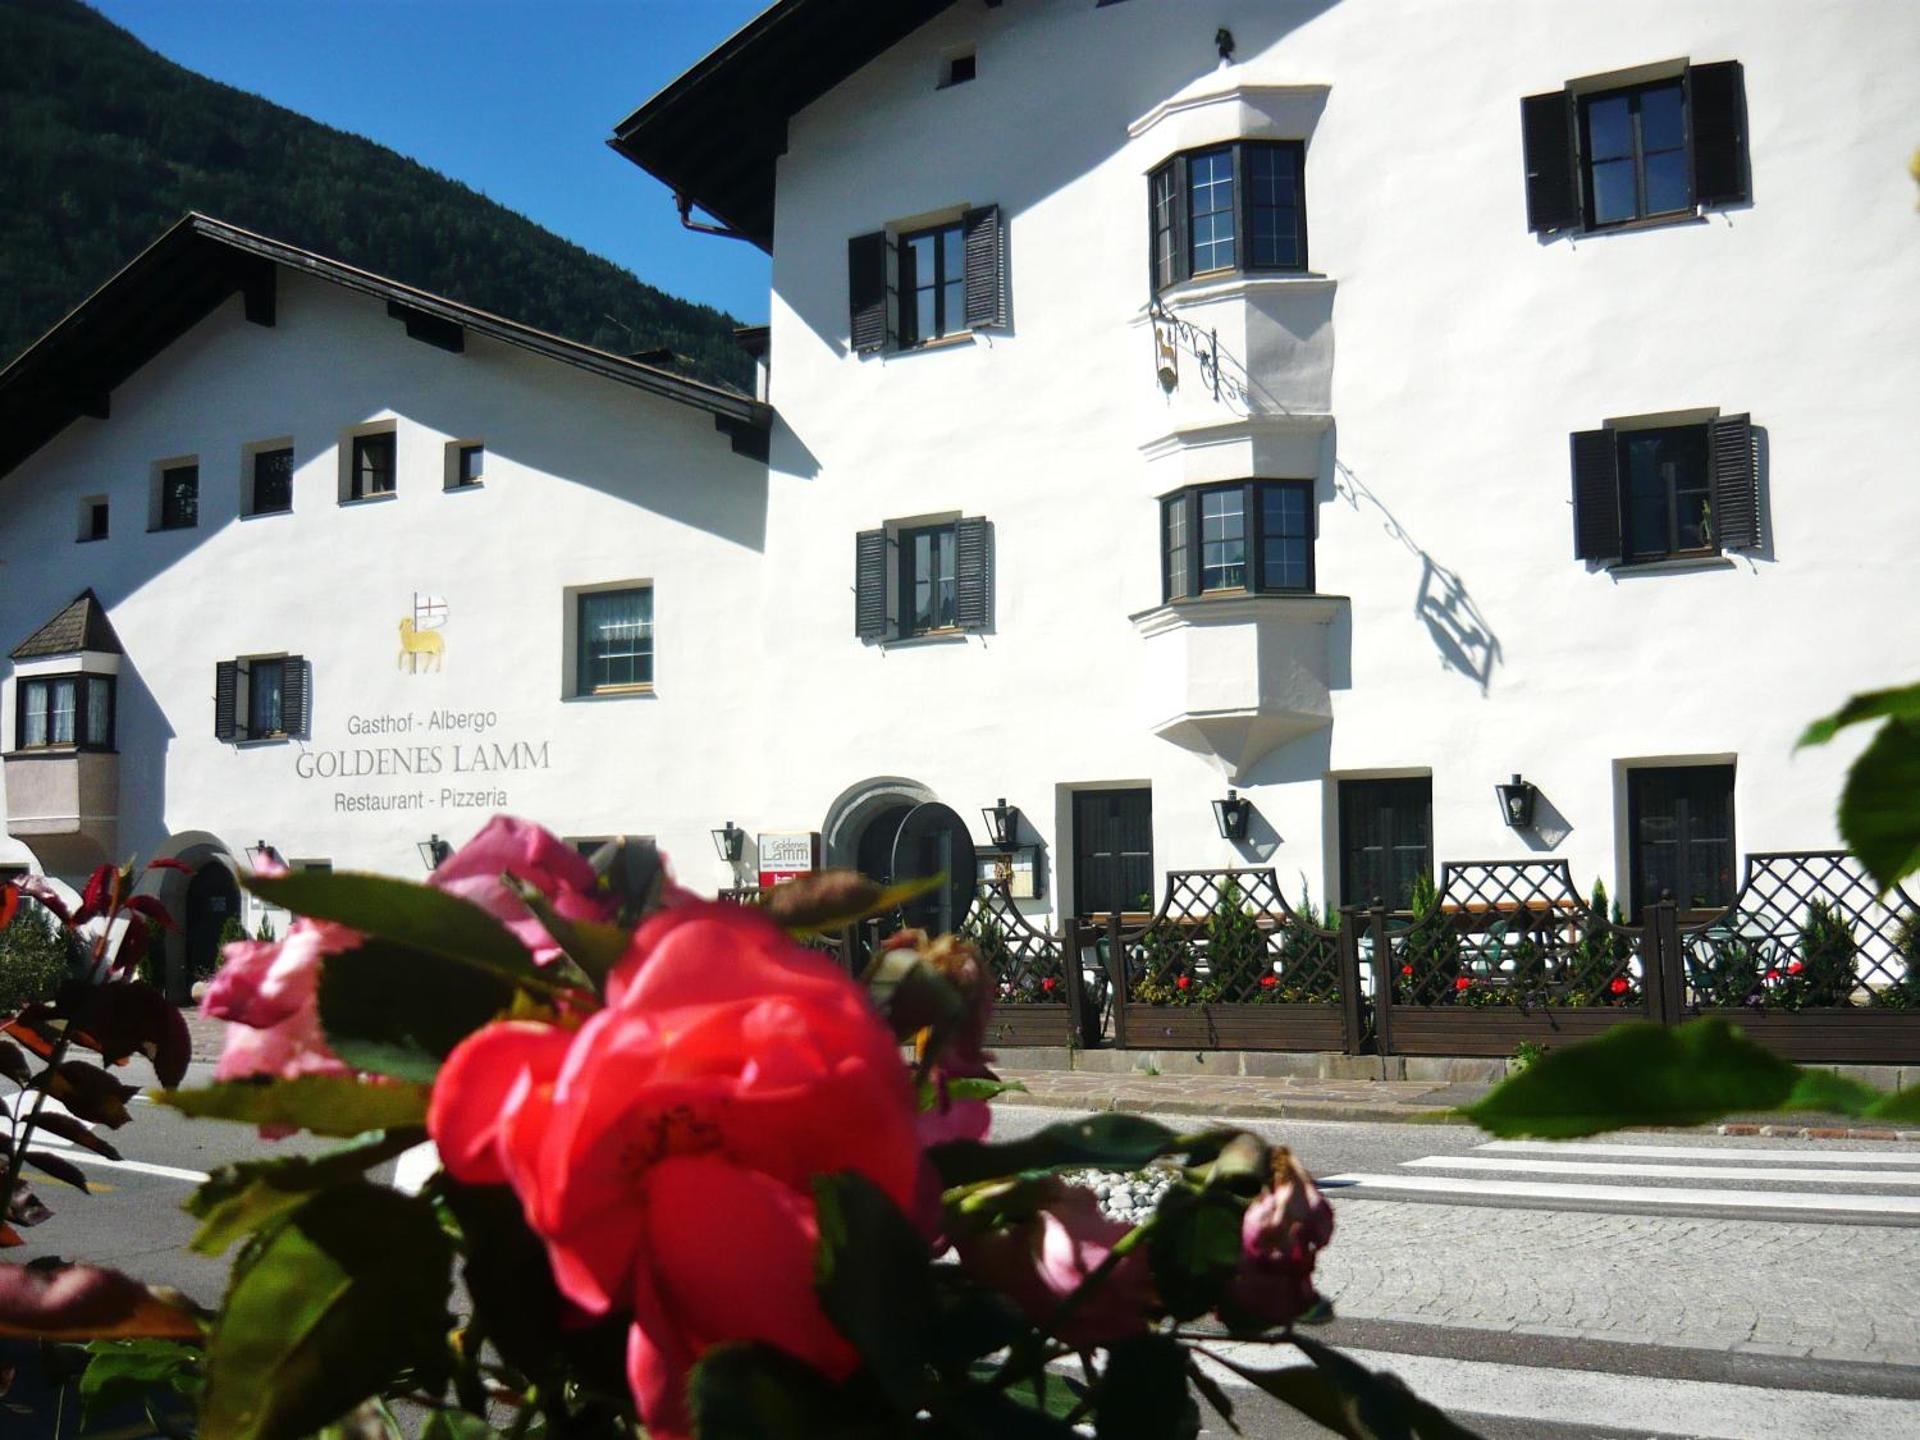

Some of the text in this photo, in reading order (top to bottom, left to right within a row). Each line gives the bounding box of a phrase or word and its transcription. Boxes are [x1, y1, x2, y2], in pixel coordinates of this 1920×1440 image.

[348, 713, 413, 735] Gasthof
[429, 710, 497, 732] Albergo
[296, 741, 551, 779] GOLDENES LAMM
[335, 790, 423, 812] Restaurant
[440, 787, 507, 808] Pizzeria
[762, 844, 809, 861] Lamm
